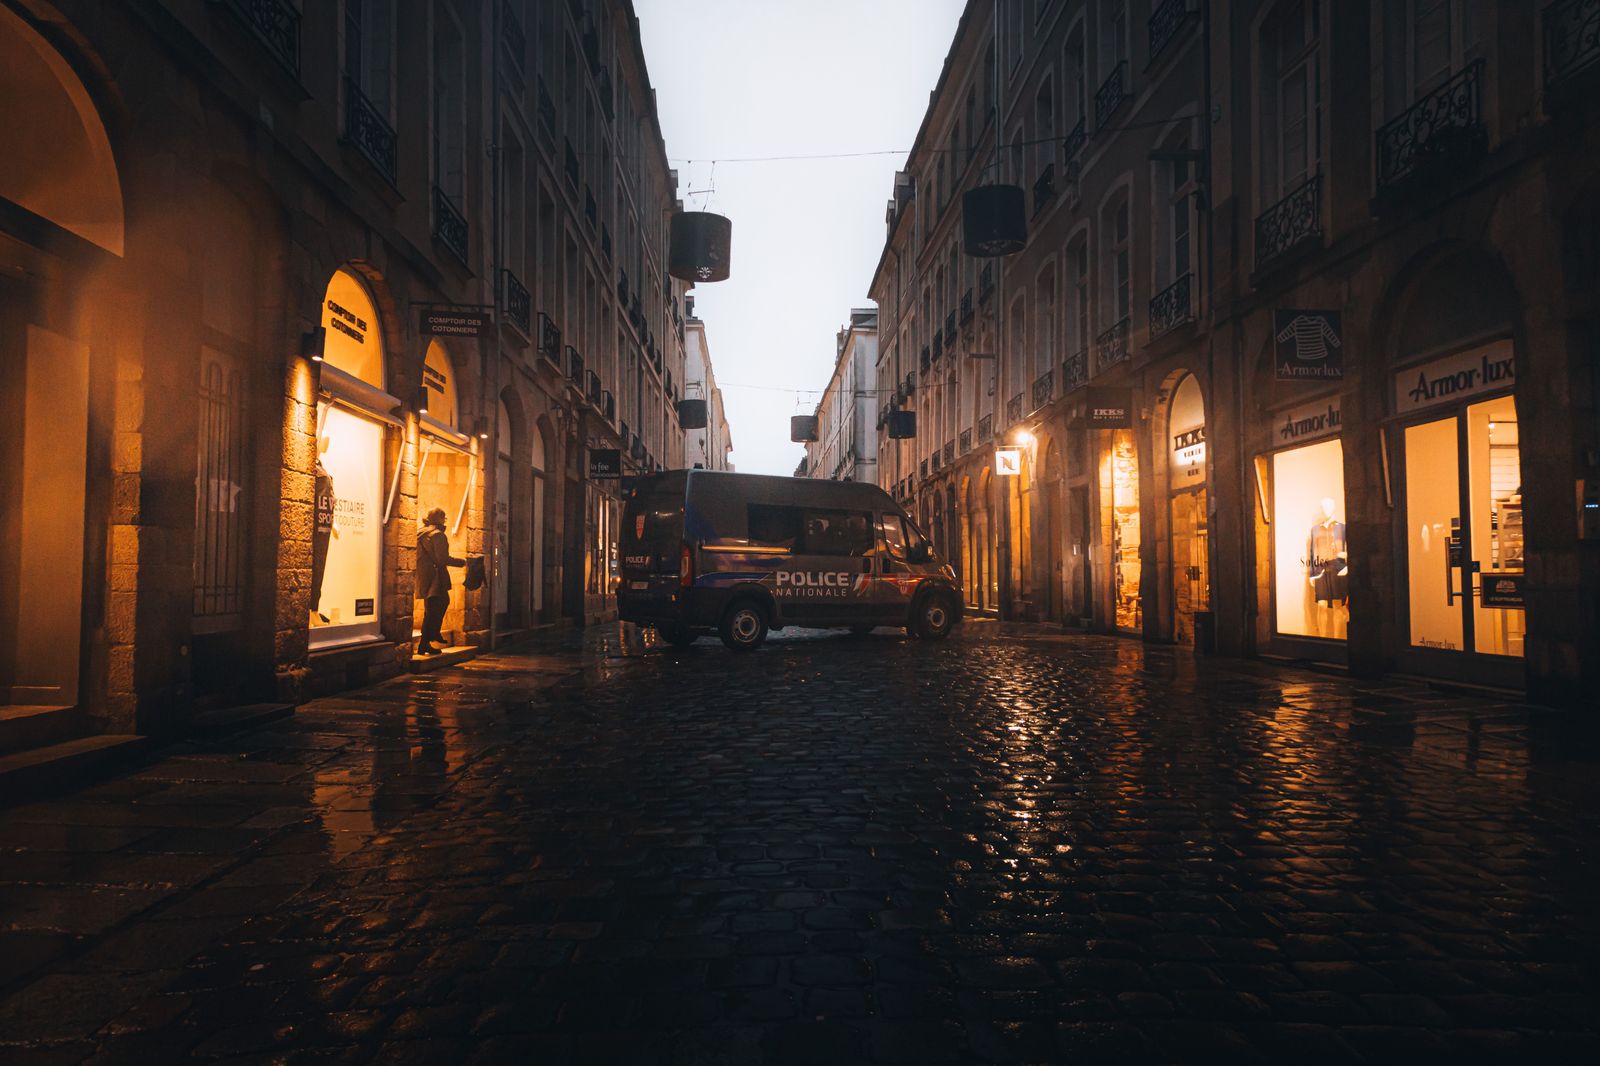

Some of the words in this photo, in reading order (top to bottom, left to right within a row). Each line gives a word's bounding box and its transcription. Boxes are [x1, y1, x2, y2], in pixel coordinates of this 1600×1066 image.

[428, 316, 466, 325] COMPTOIR
[432, 325, 477, 334] COTONNIERS
[1093, 408, 1125, 416] IKKS
[318, 495, 328, 510] LE
[329, 496, 365, 515] VESTIAIRE
[624, 556, 645, 564] POLICE
[776, 571, 850, 587] POLICE
[776, 587, 848, 598] NATIONALE
